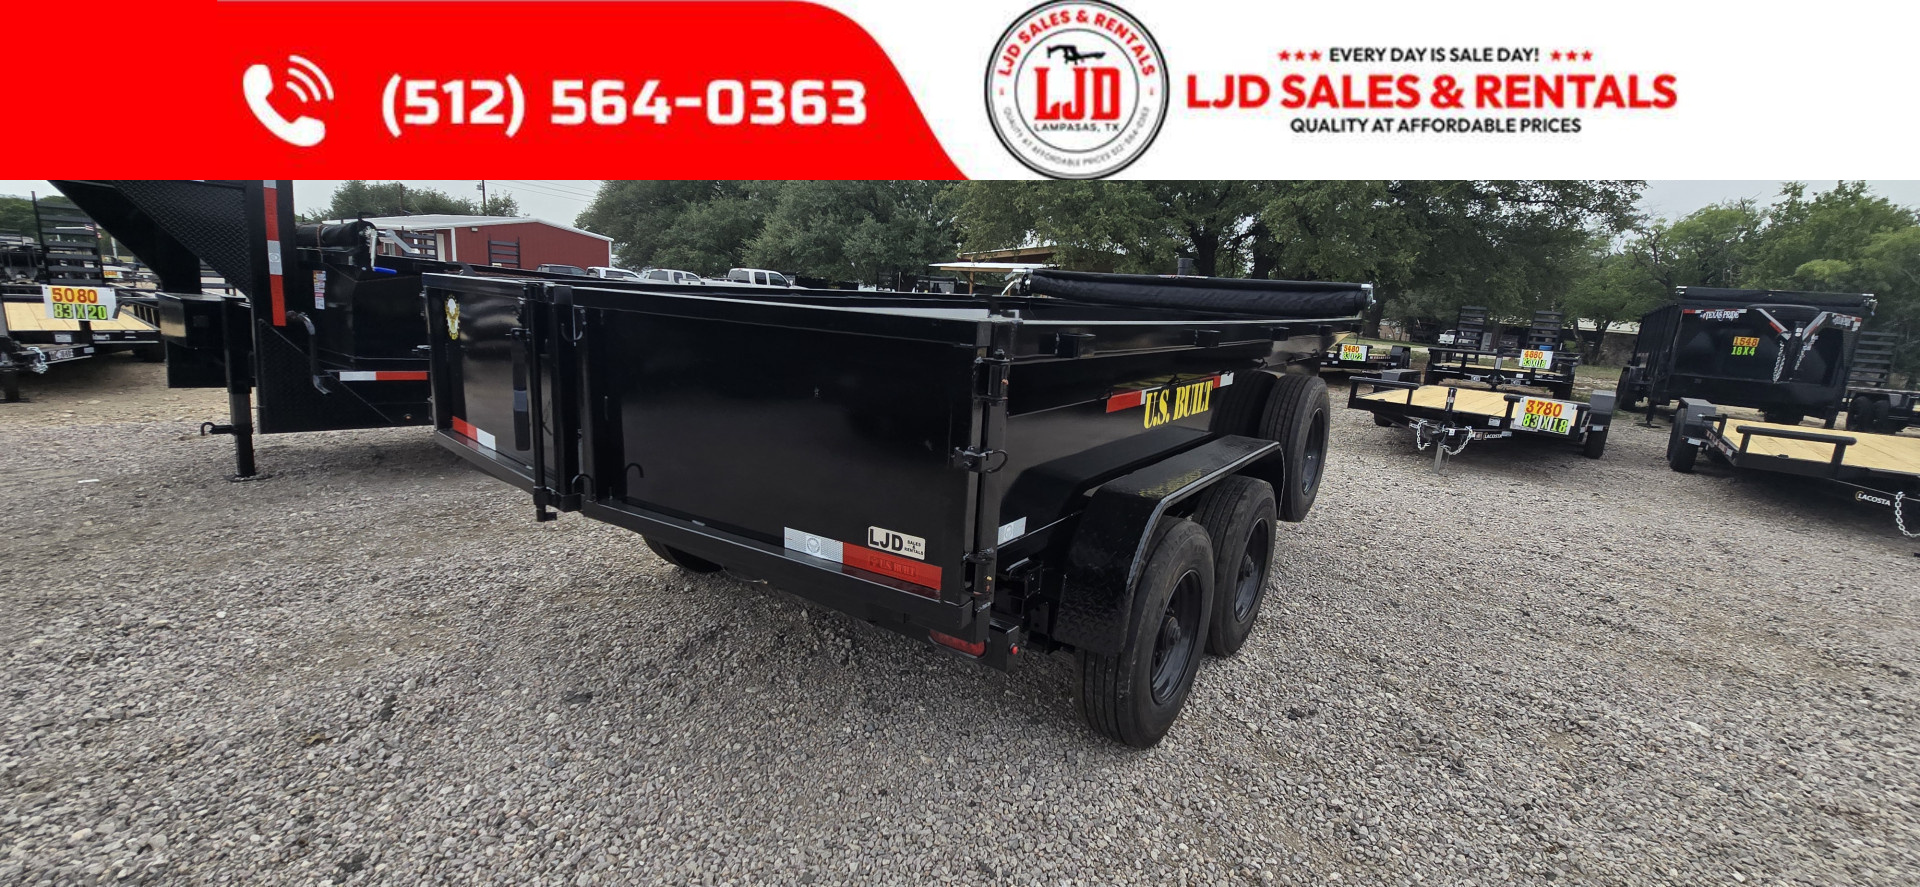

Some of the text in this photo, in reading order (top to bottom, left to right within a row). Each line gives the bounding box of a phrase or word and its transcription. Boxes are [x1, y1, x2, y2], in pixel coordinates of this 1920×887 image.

[52, 287, 98, 304] 5080
[1144, 380, 1213, 429] U.S. BUILT
[1526, 400, 1562, 417] 3780
[1857, 492, 1891, 506] LACOSTA
[870, 528, 903, 551] LJD
[904, 546, 923, 556] RENTALS
